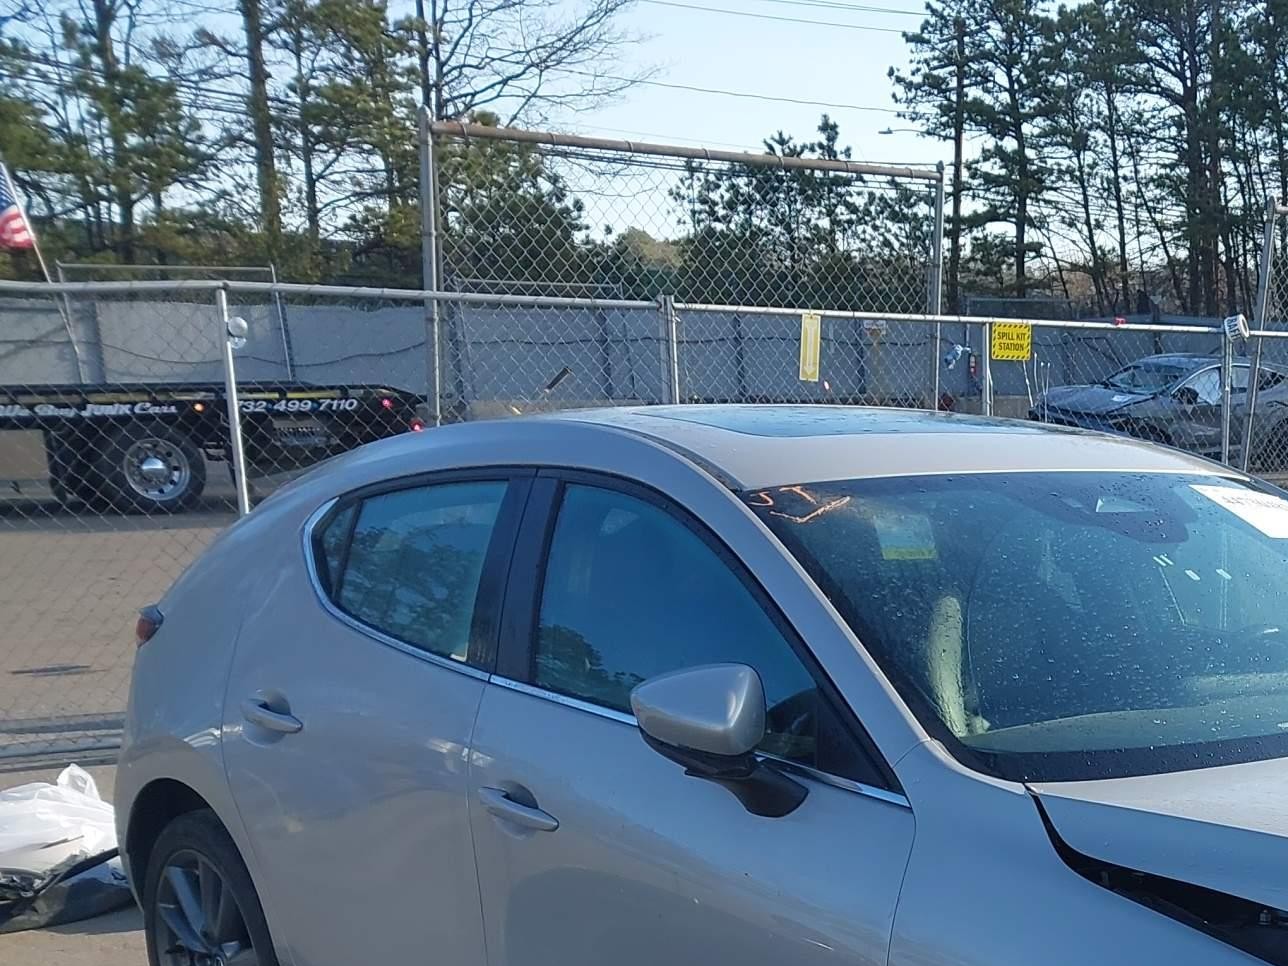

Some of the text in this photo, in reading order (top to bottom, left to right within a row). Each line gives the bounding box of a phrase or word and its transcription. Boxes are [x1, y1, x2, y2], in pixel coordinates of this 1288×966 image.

[997, 331, 1027, 342] SPILL KIT
[998, 342, 1024, 352] STATION
